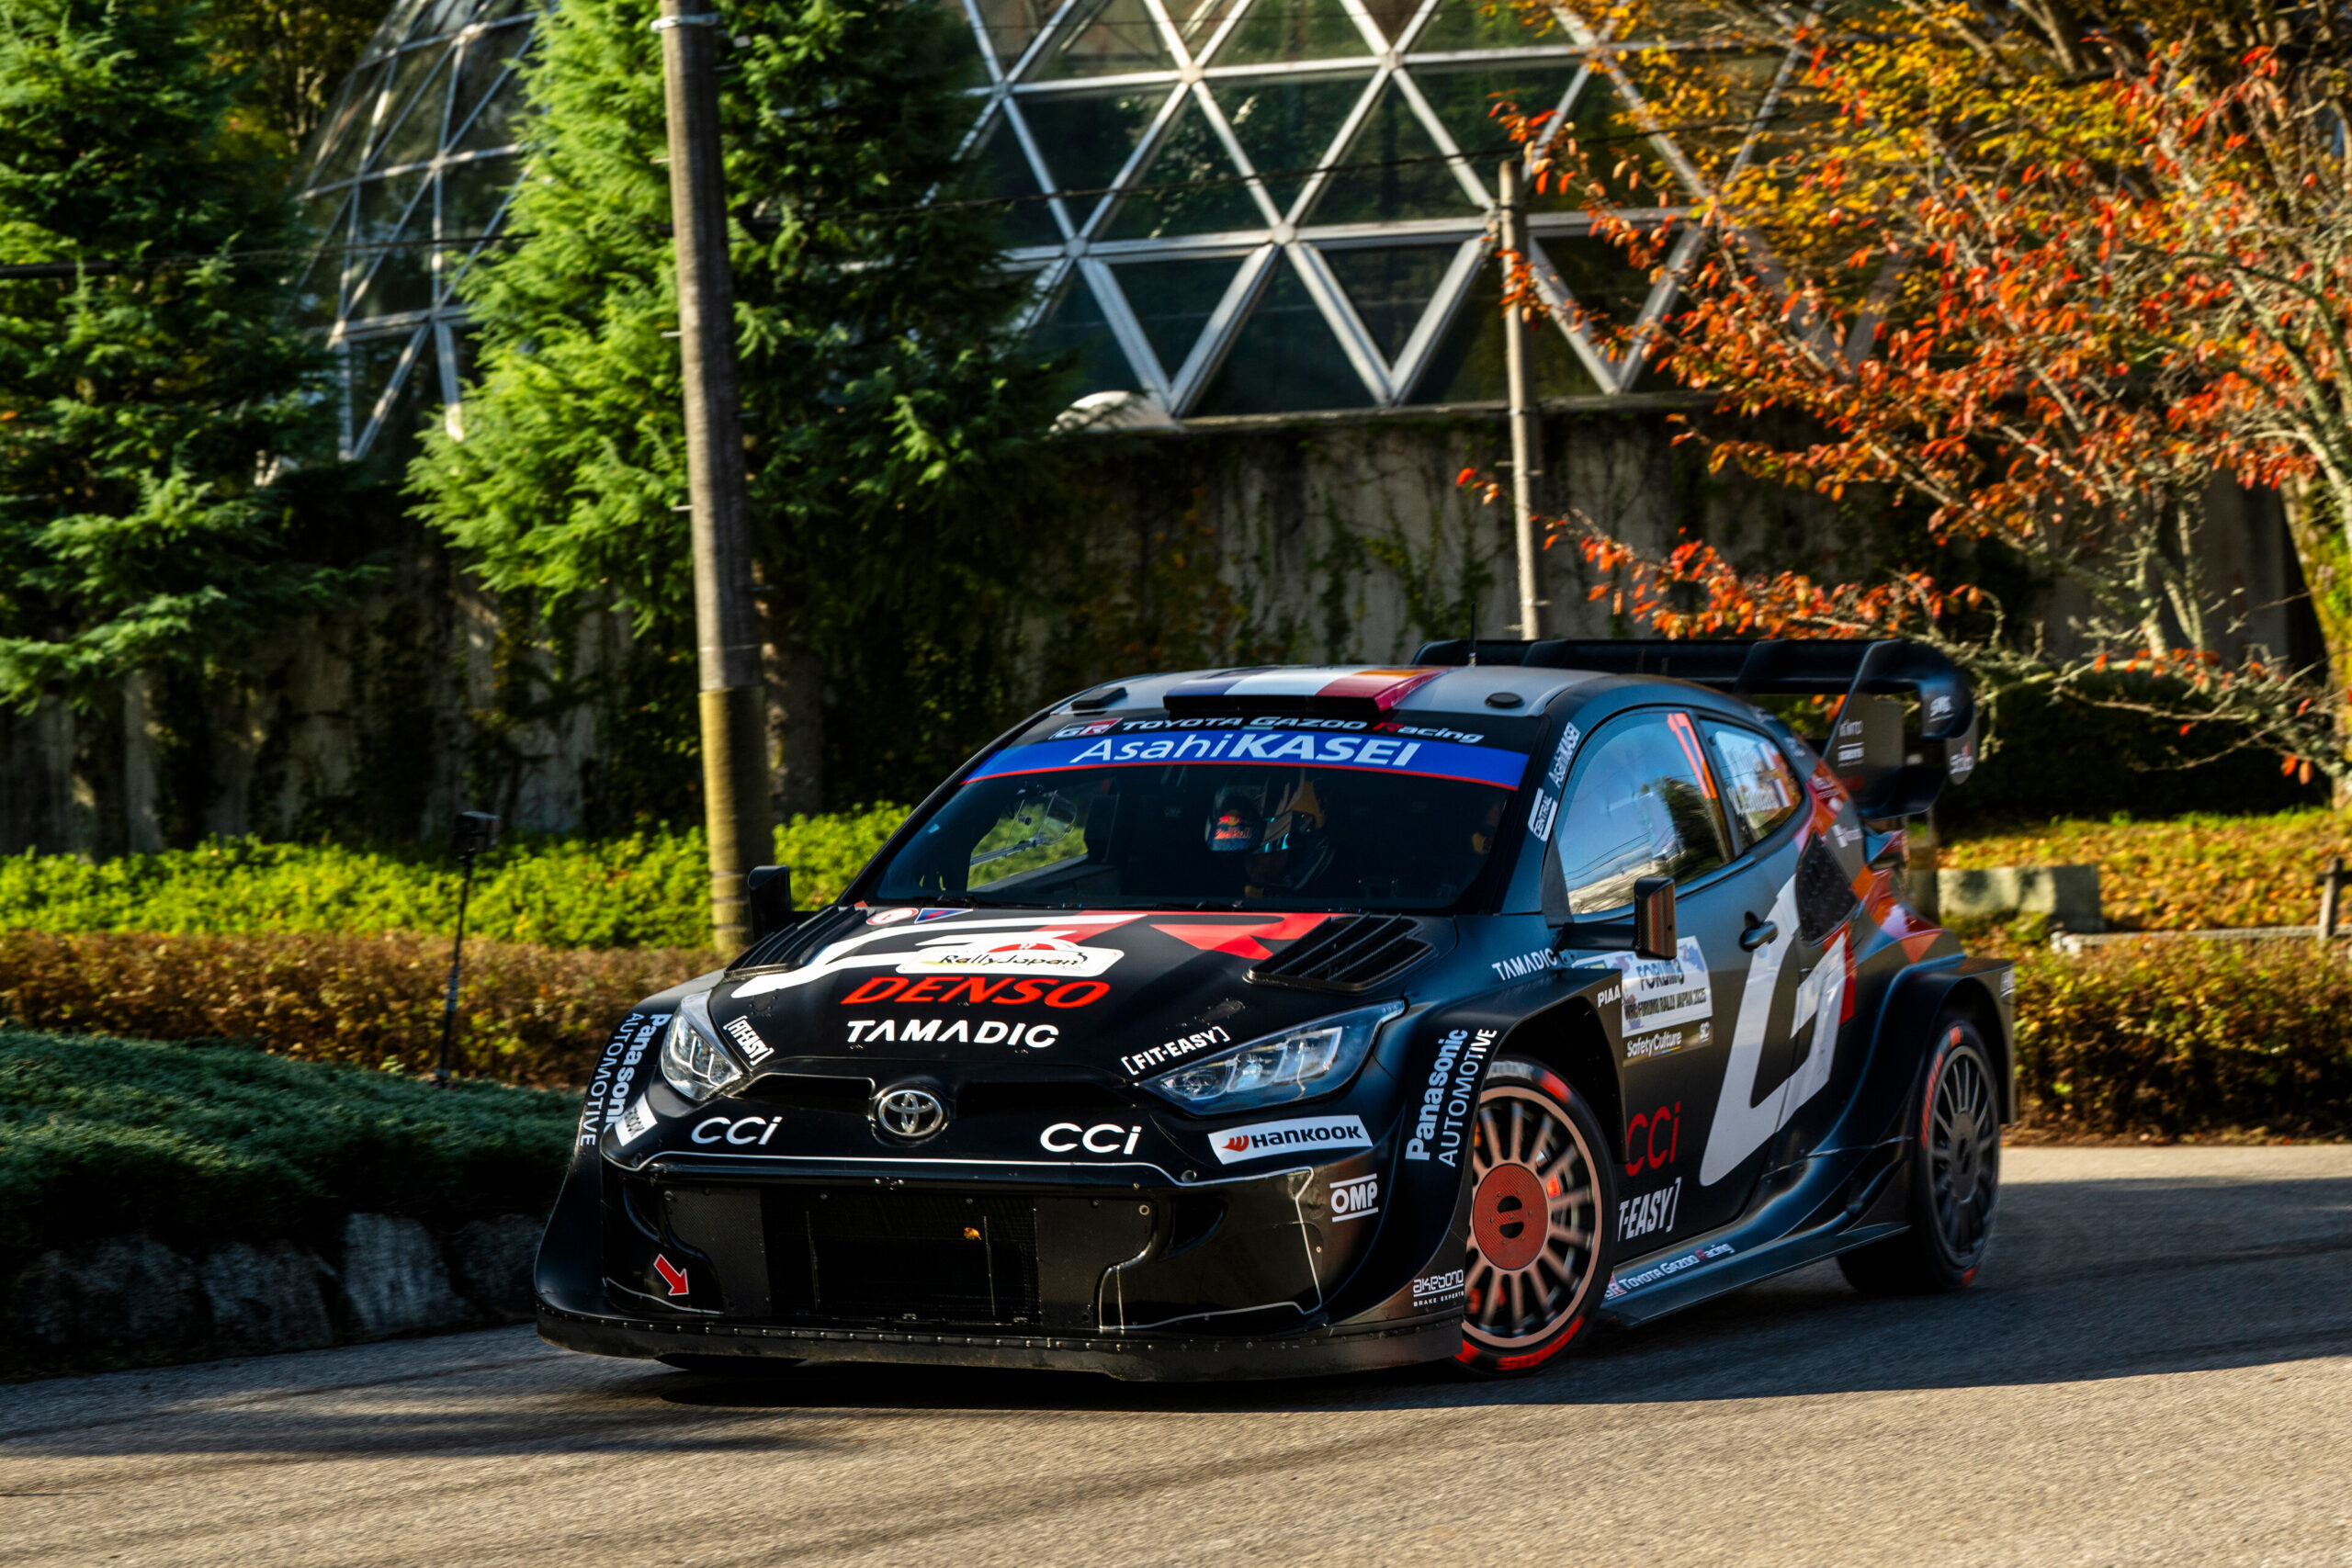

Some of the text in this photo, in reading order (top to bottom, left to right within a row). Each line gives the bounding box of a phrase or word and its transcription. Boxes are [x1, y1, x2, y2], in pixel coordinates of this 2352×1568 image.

[1123, 716, 1243, 731] TOYOTA
[1250, 716, 1368, 730] GAZOO
[1373, 722, 1485, 743] Racing
[1491, 947, 1559, 981] TAMADIC
[841, 976, 1111, 1009] DENSO
[1597, 985, 1622, 1008] PIAA
[847, 1018, 1059, 1048] TAMADIC
[580, 1013, 645, 1147] AUTOMOTIVE
[602, 1013, 673, 1134] Panasoni
[1405, 1029, 1469, 1161] Panasonic
[1438, 1029, 1498, 1168] AUTOMOTIVE
[1330, 1181, 1378, 1213] OMP
[1619, 1268, 1666, 1290] TOYOTA
[1660, 1255, 1700, 1274] GAZOO
[1694, 1243, 1736, 1260] Racing
[1413, 1290, 1464, 1307] BRAKE EXPERTS
